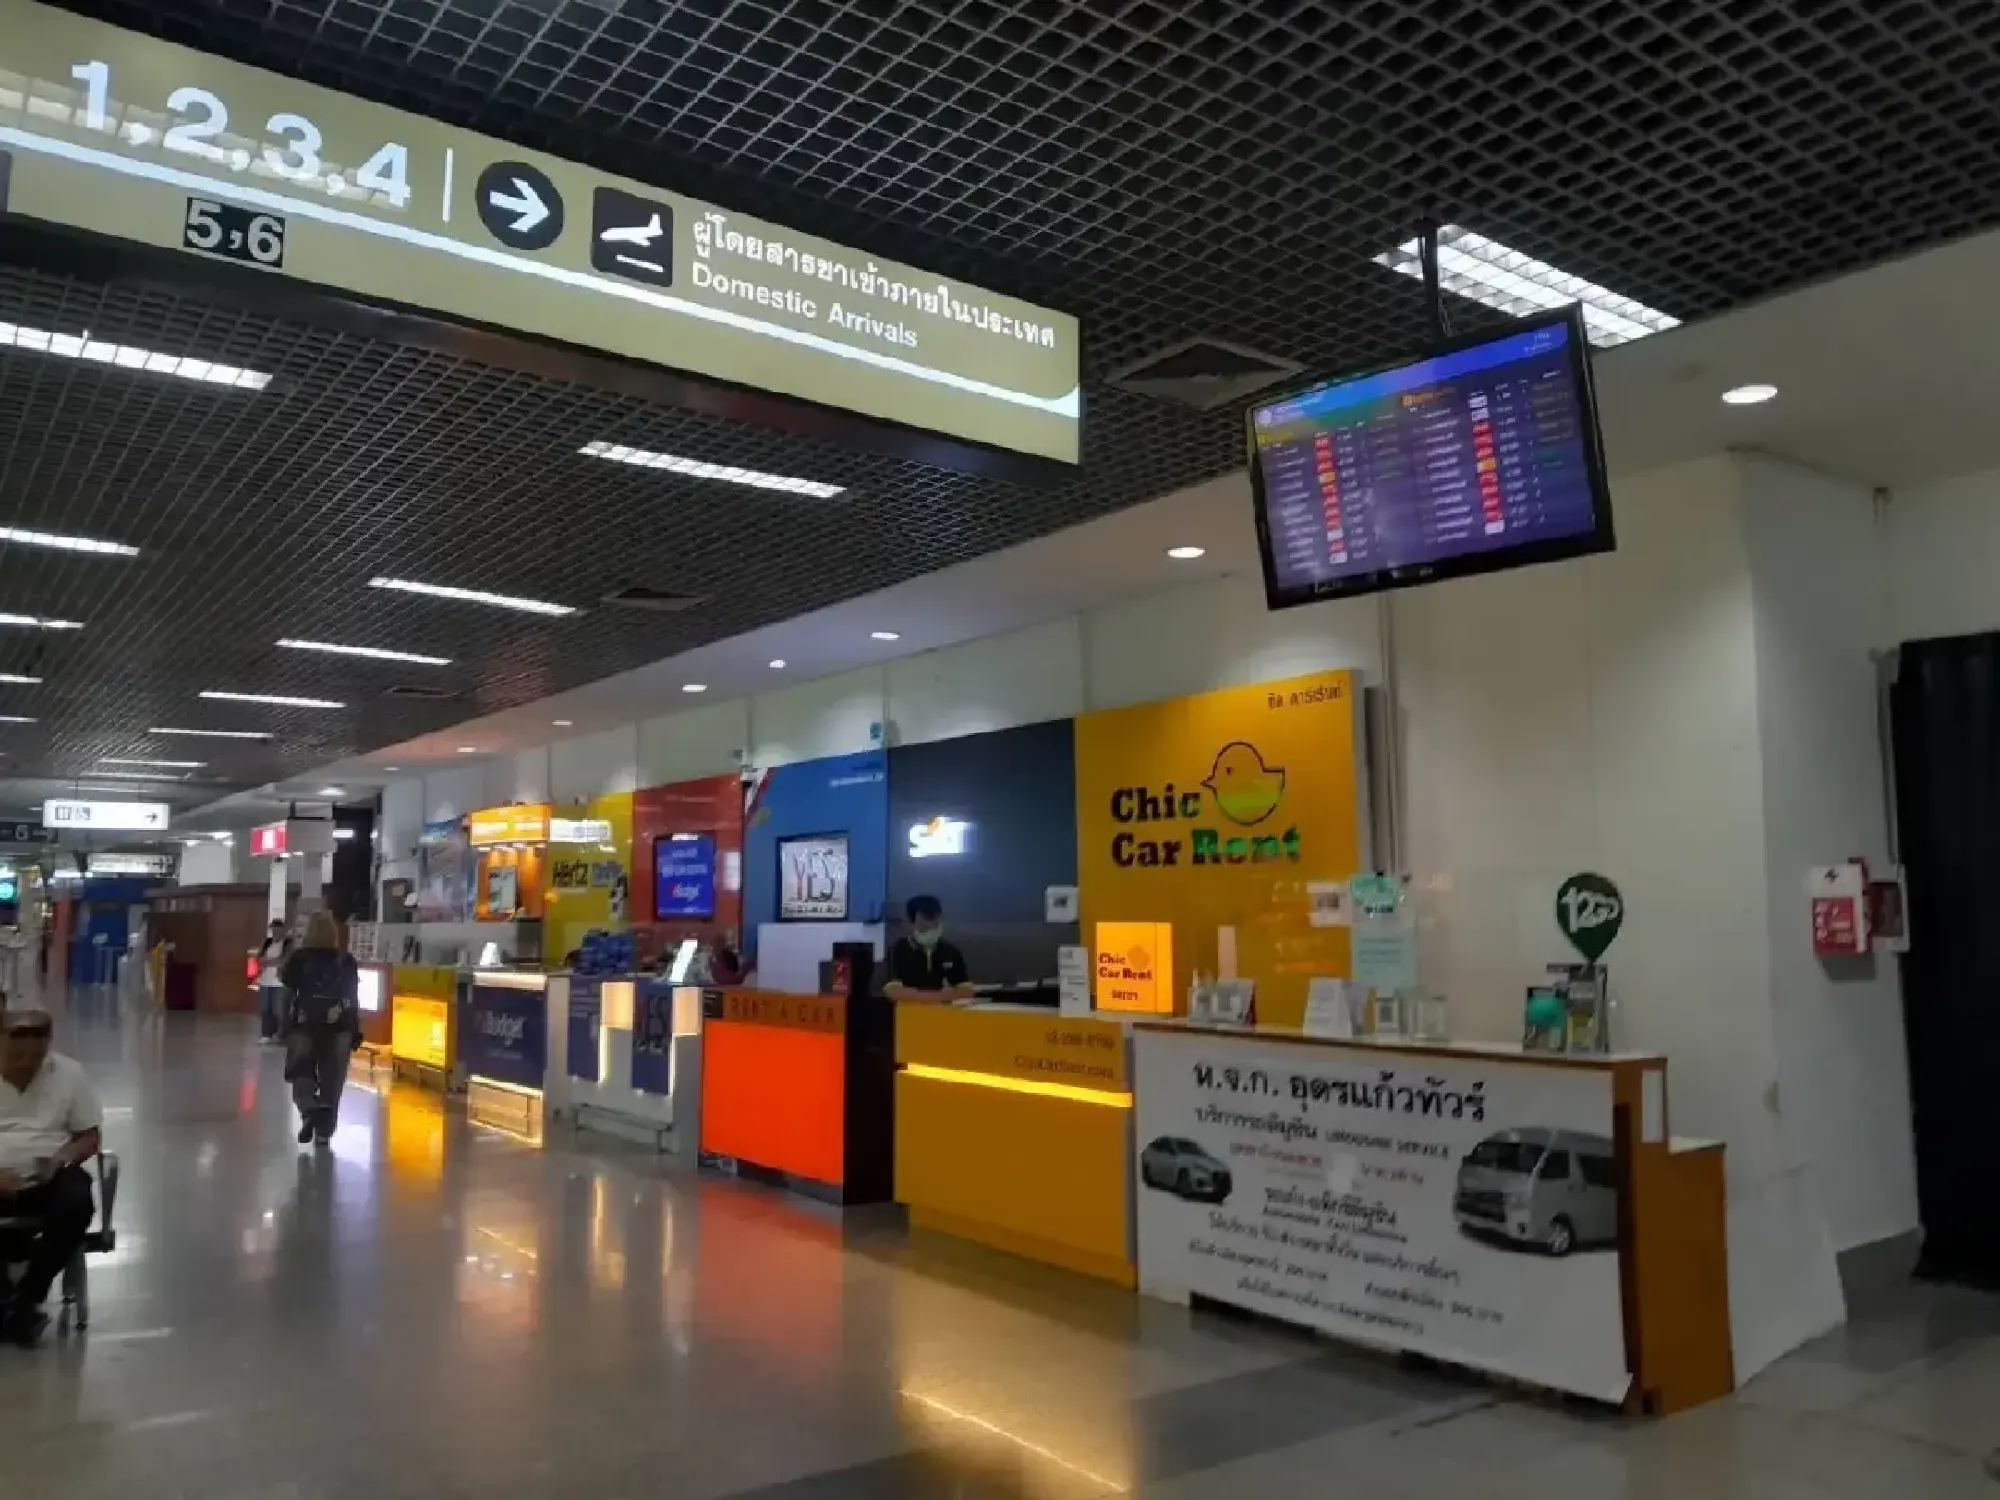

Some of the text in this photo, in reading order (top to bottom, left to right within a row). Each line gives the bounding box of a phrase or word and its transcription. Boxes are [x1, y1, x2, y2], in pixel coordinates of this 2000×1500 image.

[72, 60, 411, 208] 1,2,3,4
[187, 200, 283, 264] 5,6
[692, 211, 1055, 348] ผู้โดยสารขาเข้าภายในประเทศ
[692, 261, 918, 348] Domestic Arrivals
[1111, 784, 1200, 823] Chic
[1112, 824, 1301, 867] Car Rent
[1099, 952, 1126, 966] Chic
[1099, 966, 1153, 980] Car Rent
[1289, 1070, 1486, 1122] อุดรแก้วทัวร์
